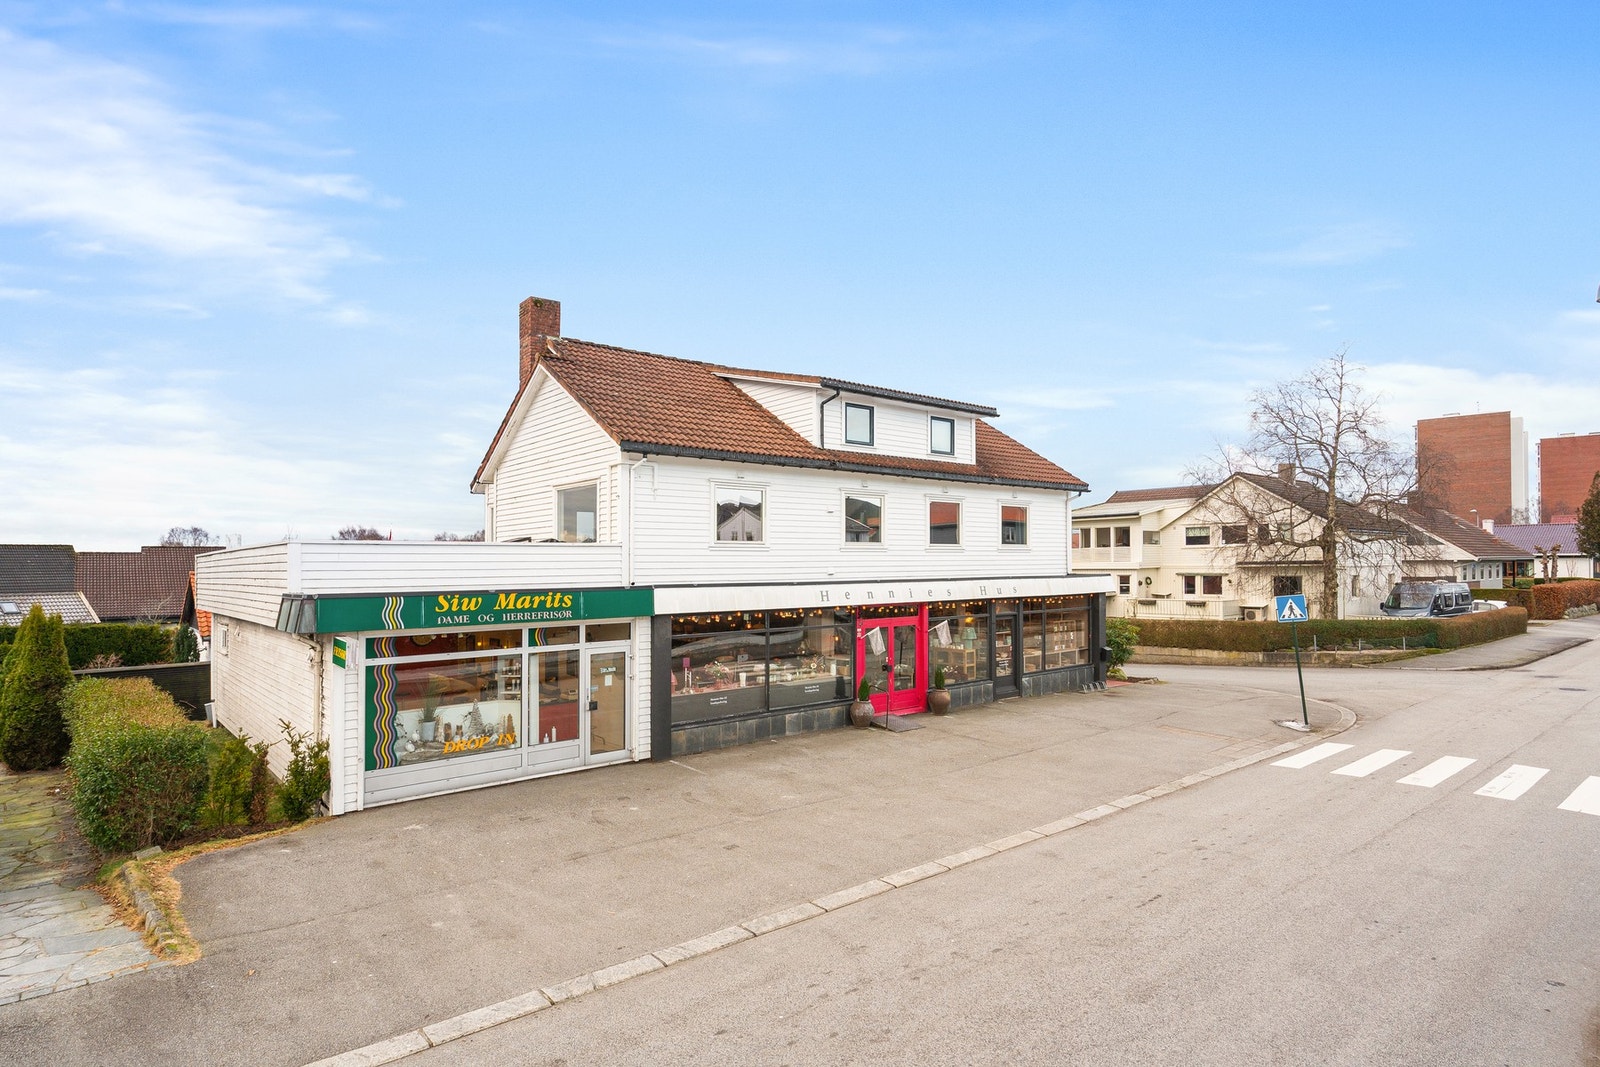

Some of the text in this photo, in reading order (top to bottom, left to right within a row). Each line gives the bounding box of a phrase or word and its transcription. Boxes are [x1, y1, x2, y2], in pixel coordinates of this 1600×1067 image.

[435, 591, 573, 613] Siw Marits
[820, 585, 1018, 602] Hennies Hus
[437, 610, 573, 625] DAME OG HERREFRISØR
[443, 732, 515, 754] DROP IN
